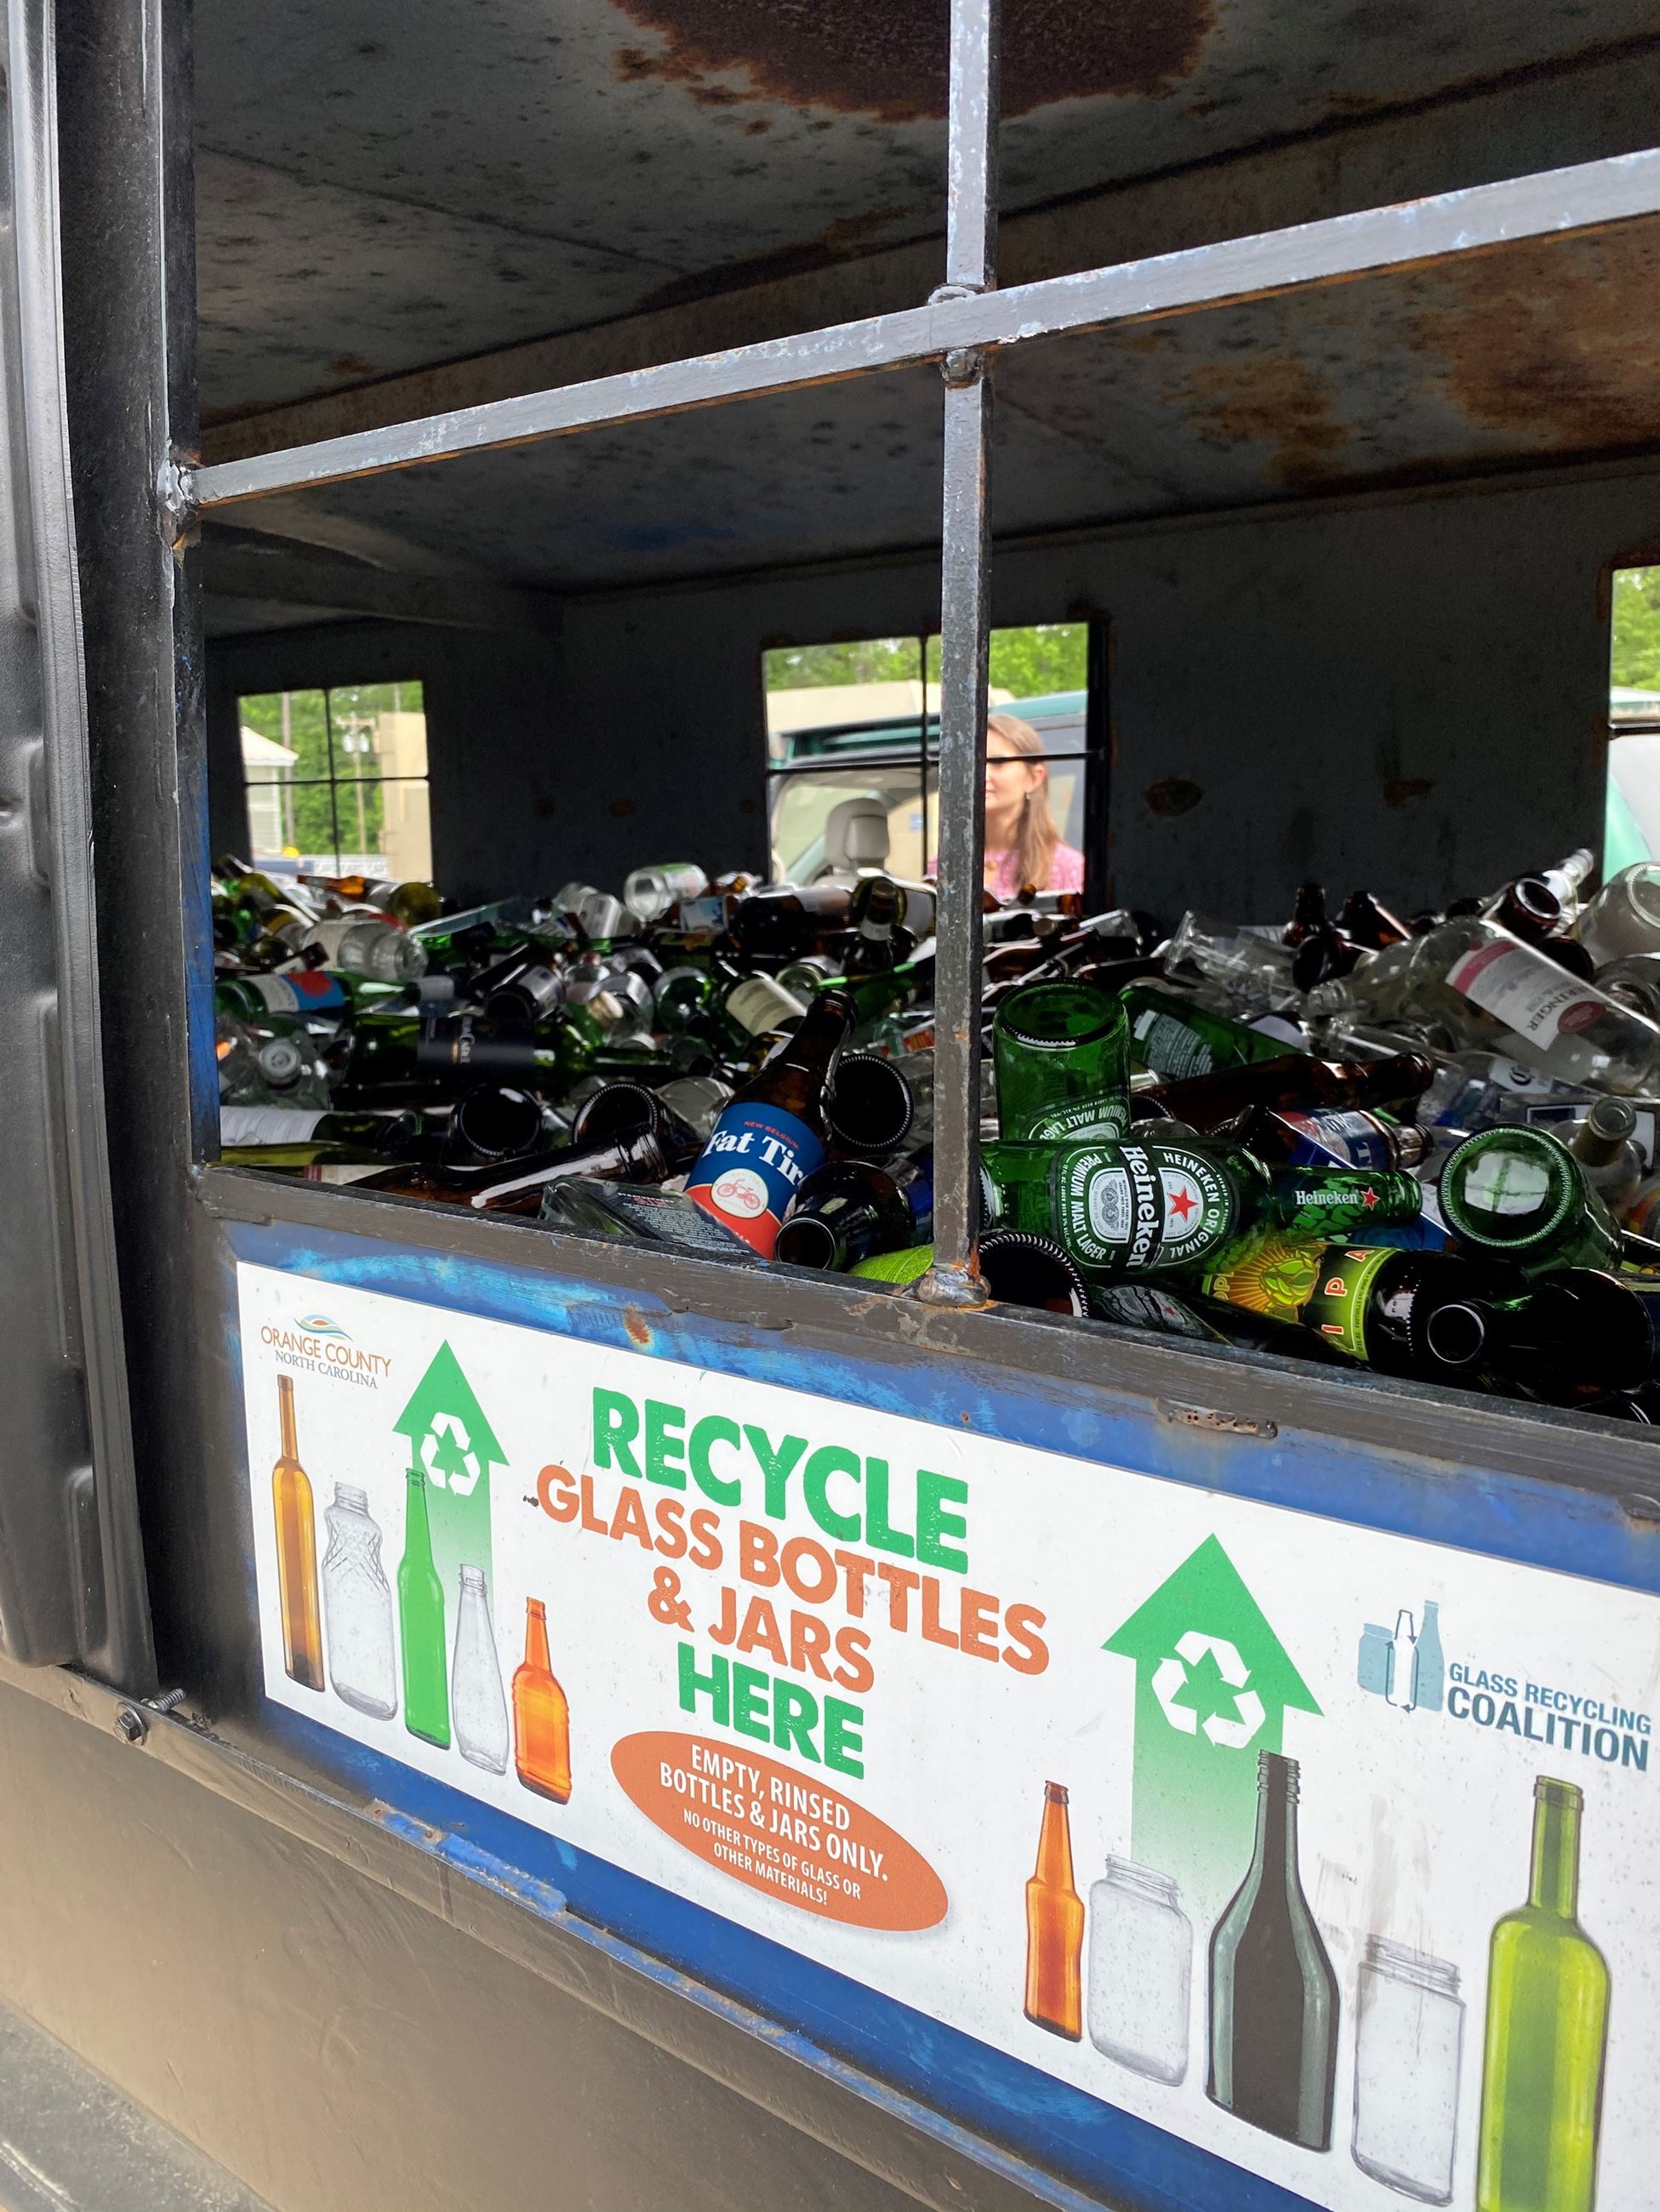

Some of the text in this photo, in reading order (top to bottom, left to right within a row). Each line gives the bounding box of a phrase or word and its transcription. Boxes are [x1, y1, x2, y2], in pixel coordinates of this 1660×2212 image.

[743, 1120, 800, 1149] NEW BELGIUM
[1065, 1109, 1095, 1129] MALT
[701, 1130, 805, 1186] Fat Tir
[1070, 1153, 1103, 1197] PREMIUM
[1070, 1200, 1087, 1234] MALT
[1119, 1146, 1160, 1268] Heineken
[1162, 1152, 1220, 1259] HEINEKEN ORIGINAL
[1295, 1190, 1359, 1205] Heineken
[1075, 1233, 1107, 1260] LAGER
[260, 1325, 391, 1377] ORANGE COUNTY
[275, 1349, 378, 1389] NORTH CAROLINA
[593, 1387, 968, 1575] RECYCLE
[536, 1465, 1050, 1675] GLASS BOTTLES
[647, 1565, 875, 1693] & JARS
[677, 1641, 864, 1780] HERE
[1447, 1686, 1650, 1772] COALITION
[1449, 1662, 1652, 1736] GLASS RECYCLING
[659, 1762, 888, 1881] BOTTLES & JARS ONLY.
[691, 1744, 850, 1831] EMPTY, RINSED
[683, 1809, 861, 1901] NO OTHER TYPES OF GLASS OR
[713, 1842, 828, 1906] OTHER MATERIALS!
